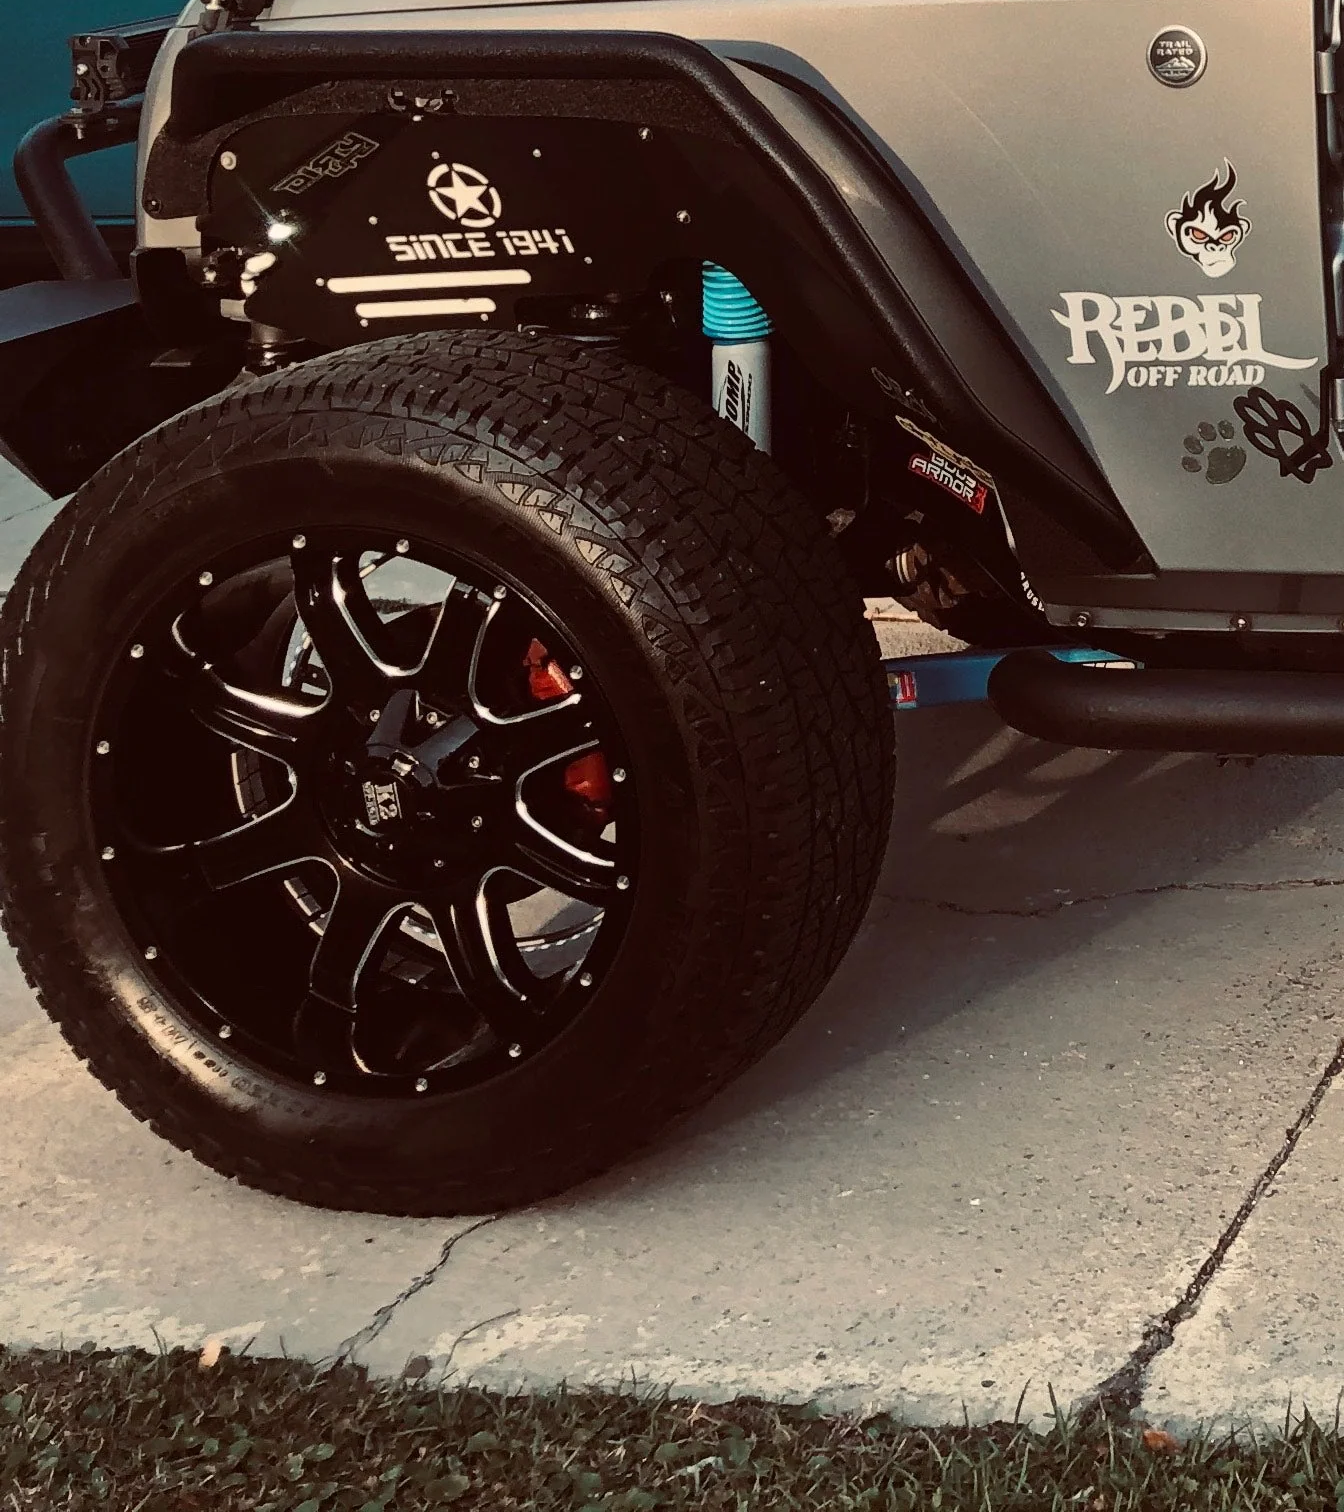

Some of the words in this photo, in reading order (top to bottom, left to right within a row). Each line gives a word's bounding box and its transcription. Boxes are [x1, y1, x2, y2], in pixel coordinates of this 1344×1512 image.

[1156, 48, 1194, 57] RATED
[1158, 40, 1192, 48] TRAIL
[496, 228, 575, 256] 1941
[1050, 291, 1319, 395] REBEL
[1126, 365, 1182, 388] OFF
[1187, 363, 1265, 387] ROAD
[724, 360, 742, 424] OMP
[911, 457, 975, 503] ARMOR
